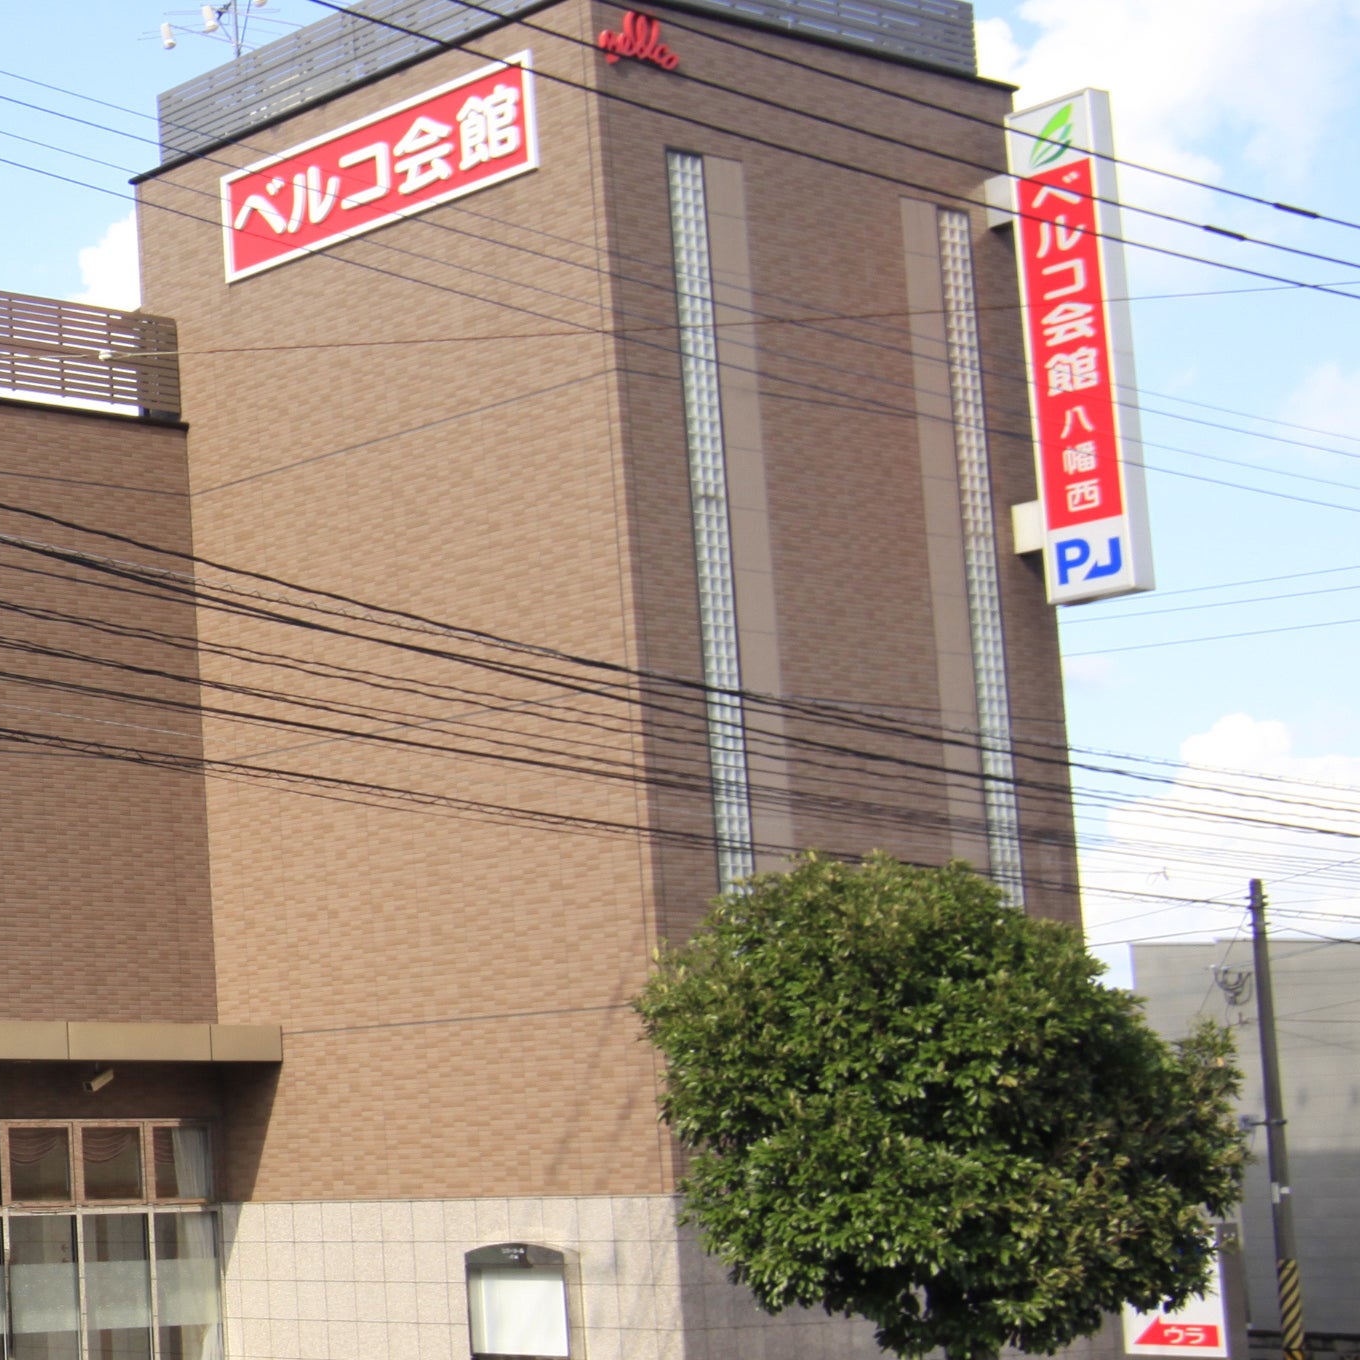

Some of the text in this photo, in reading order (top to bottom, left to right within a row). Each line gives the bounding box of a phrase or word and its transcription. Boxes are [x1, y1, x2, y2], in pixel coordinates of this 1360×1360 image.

[233, 83, 520, 234] ベルコ会館
[1162, 1326, 1206, 1345] ウラ
